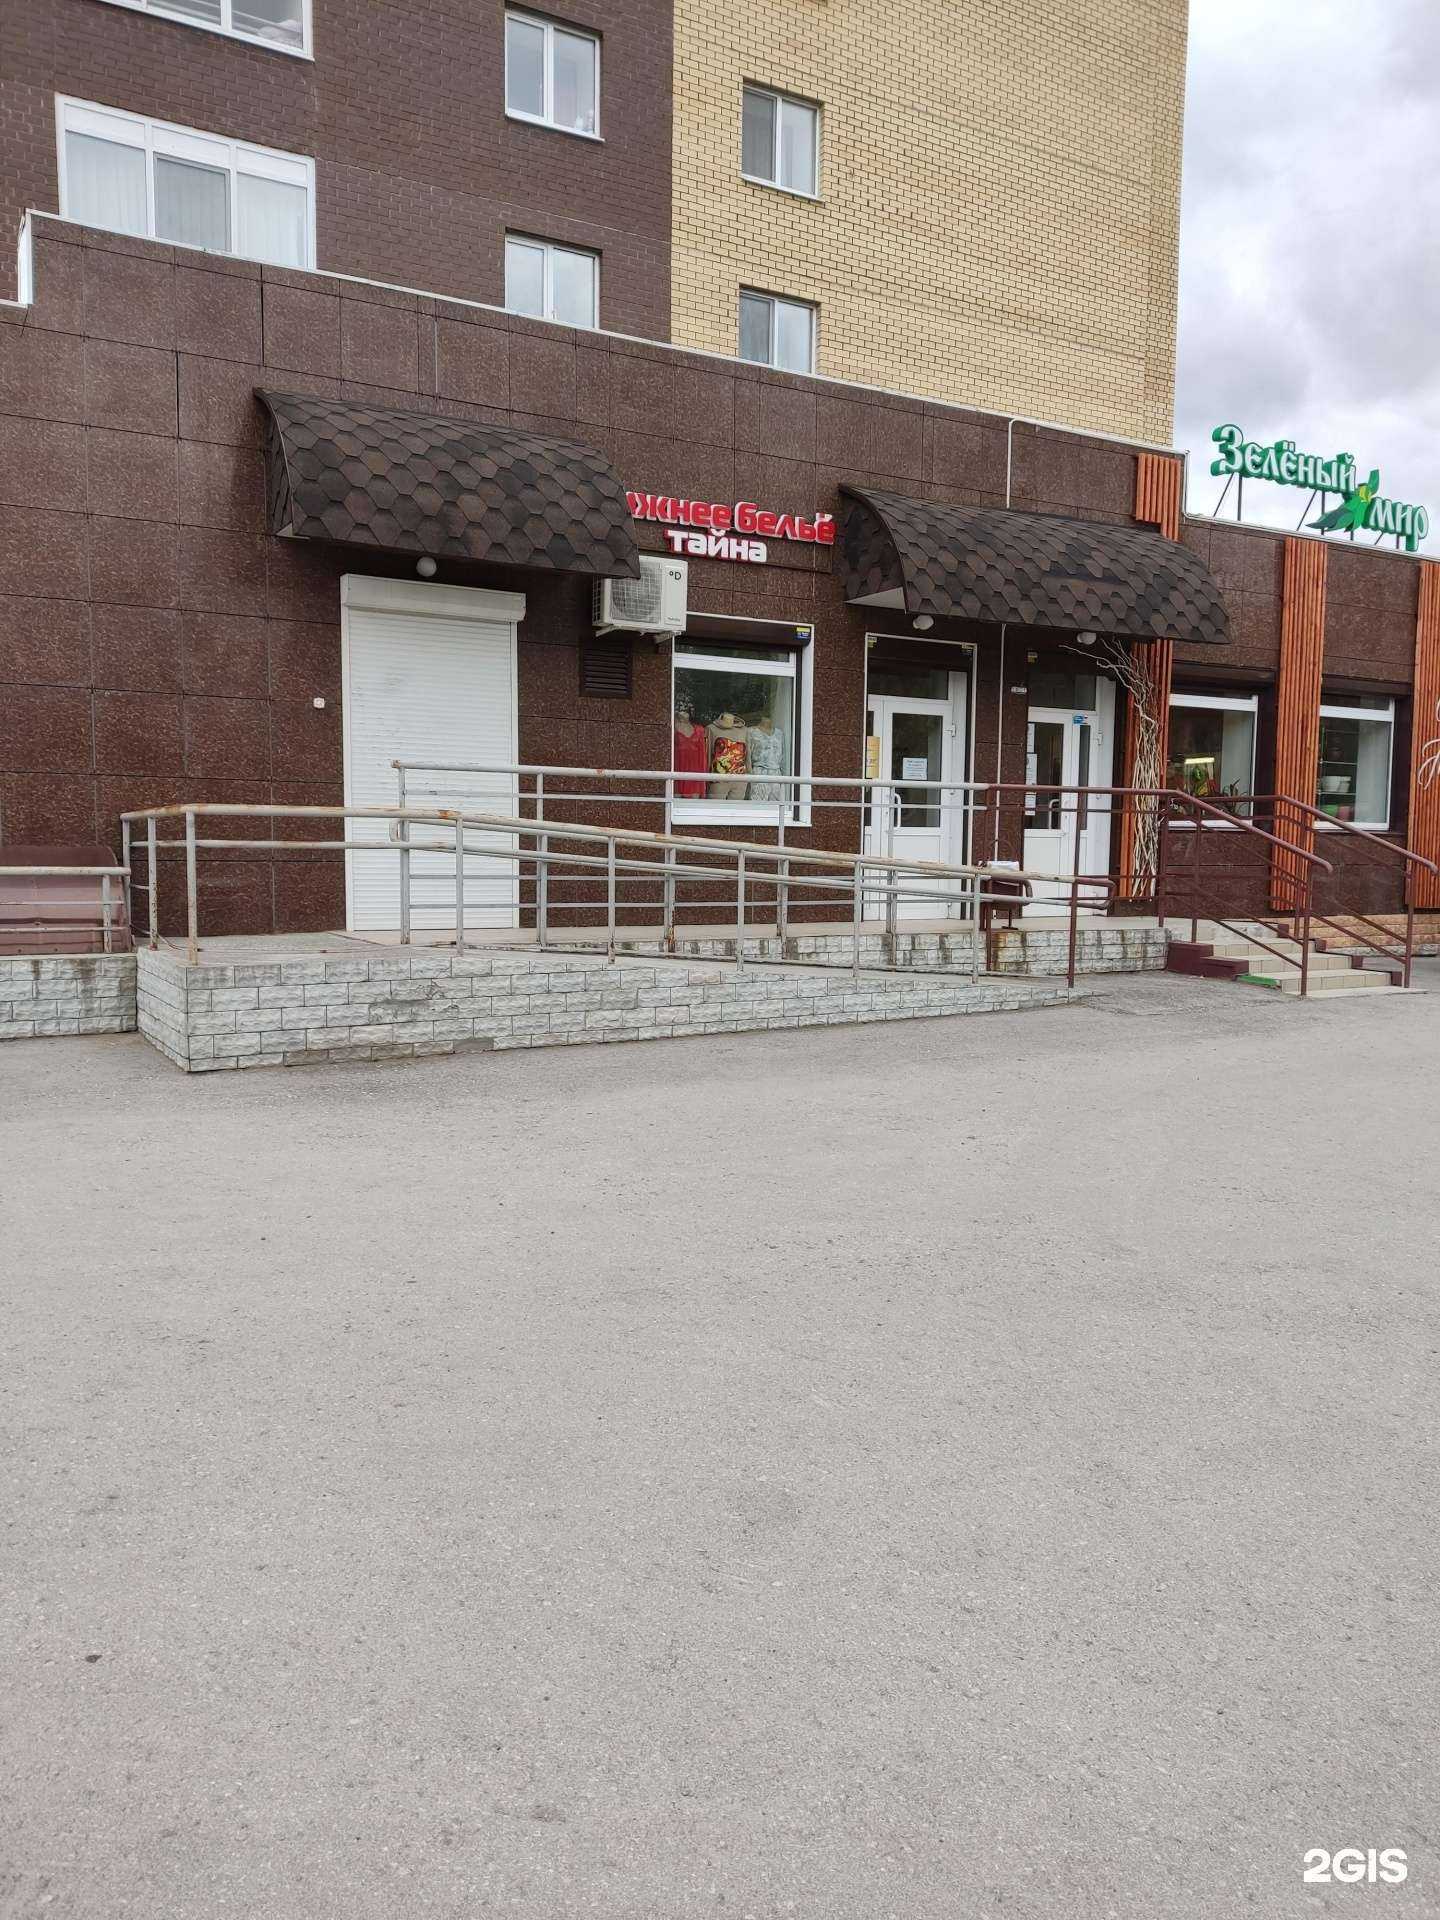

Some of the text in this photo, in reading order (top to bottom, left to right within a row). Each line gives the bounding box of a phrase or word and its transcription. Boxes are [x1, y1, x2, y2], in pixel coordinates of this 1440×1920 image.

[1210, 423, 1357, 494] Зелёный
[734, 501, 837, 545] бельё
[665, 528, 768, 563] тайна
